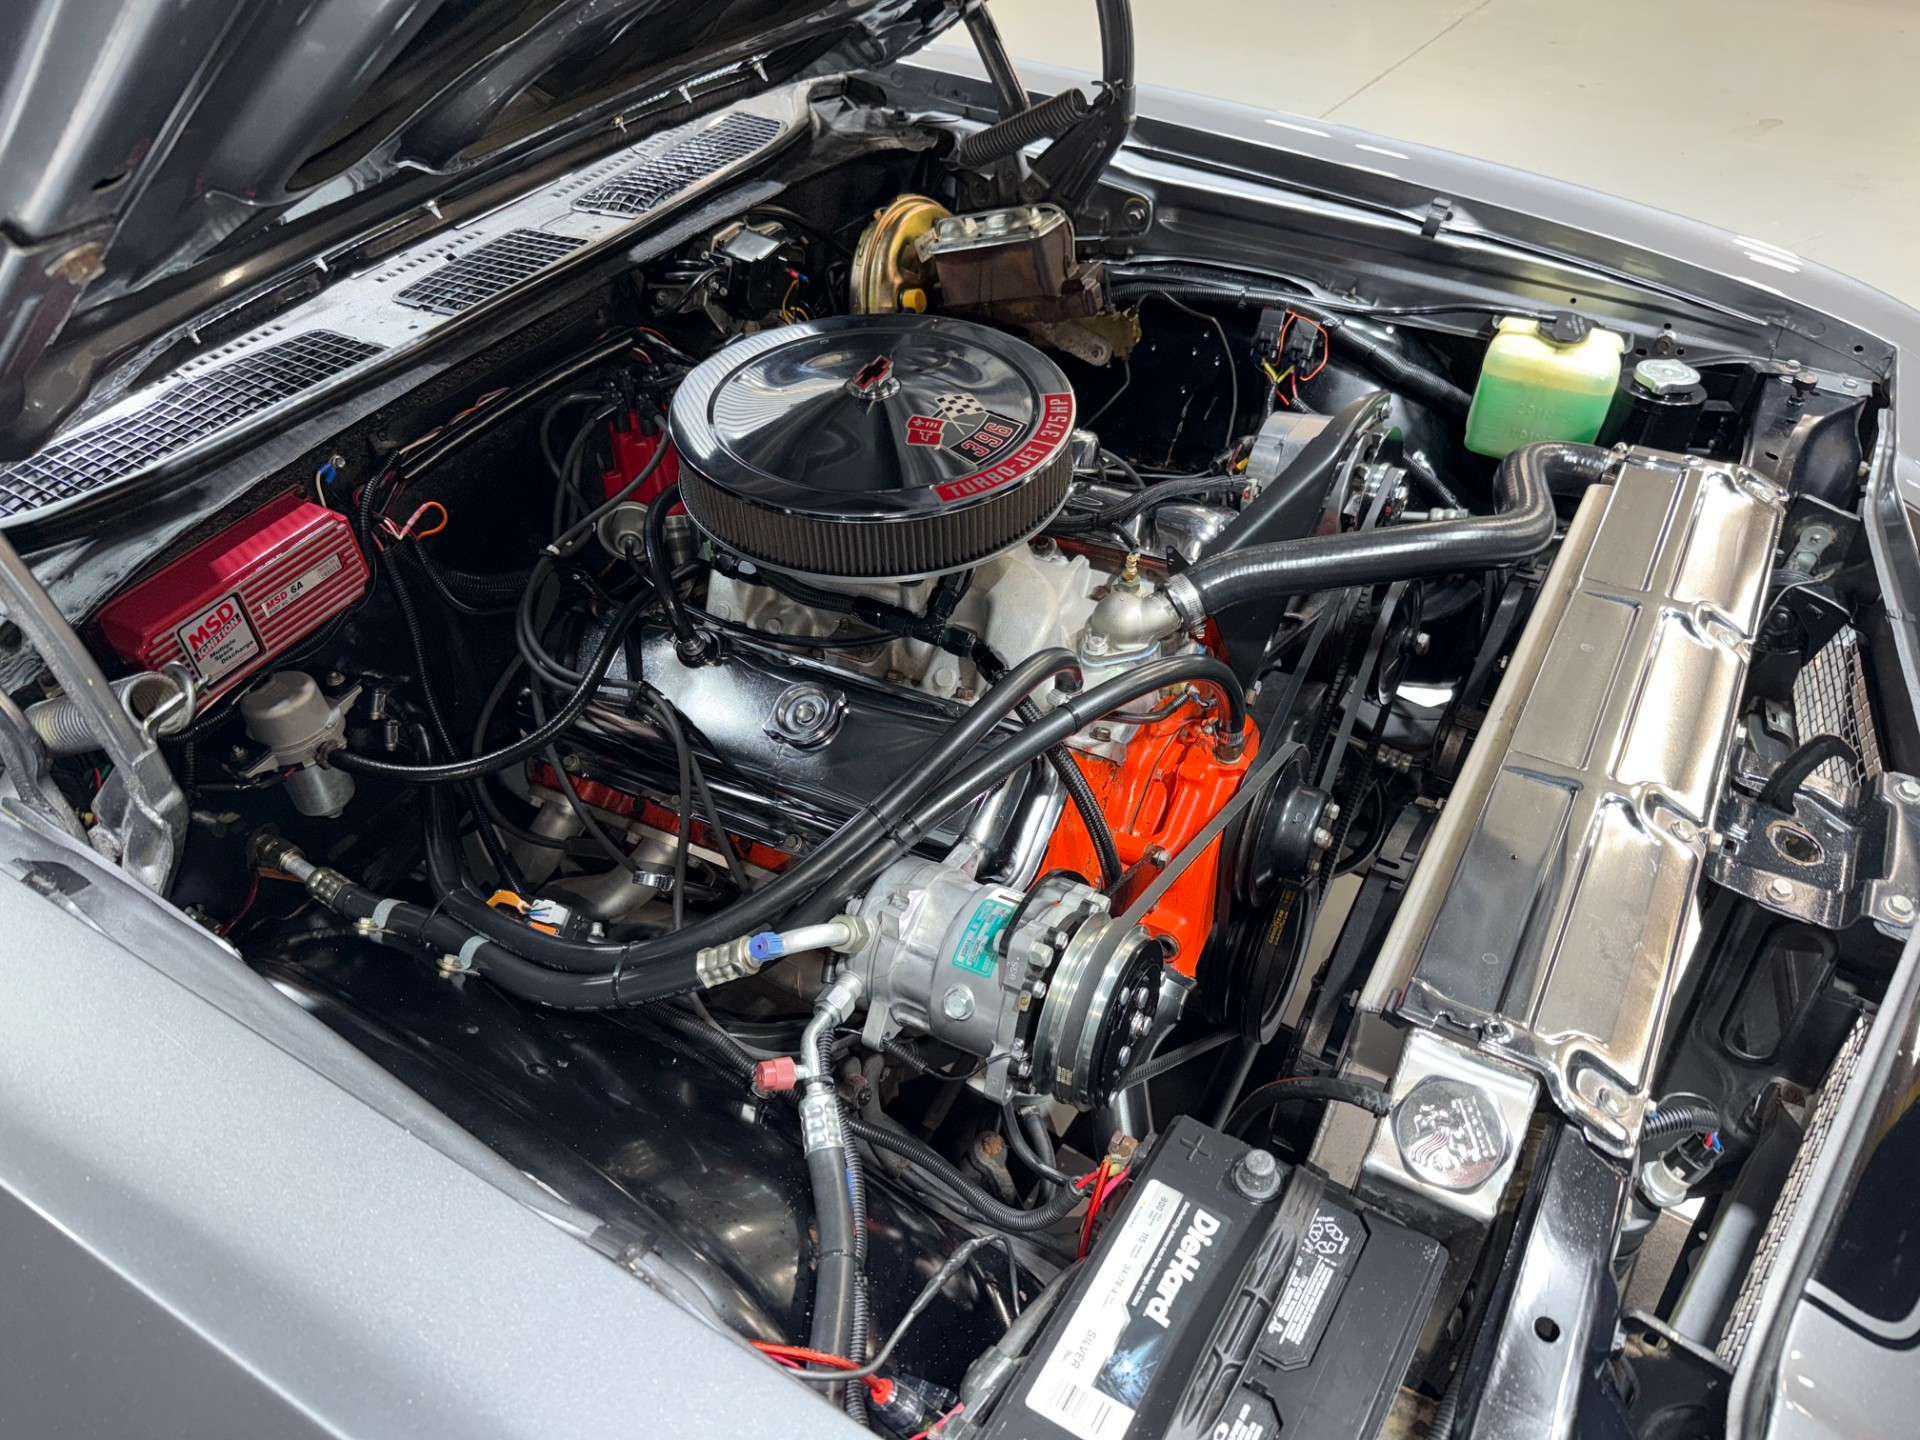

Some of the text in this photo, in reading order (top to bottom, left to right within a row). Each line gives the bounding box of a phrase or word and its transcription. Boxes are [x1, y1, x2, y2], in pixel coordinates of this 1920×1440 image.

[961, 422, 1013, 457] 396
[946, 446, 1046, 497] TURBO-JET
[265, 581, 304, 610] MSD 6A
[188, 603, 235, 652] MSD
[197, 617, 239, 660] IGNITION
[221, 640, 254, 665] Discharge
[1155, 1195, 1169, 1212] 800
[1137, 1231, 1149, 1244] 115
[1144, 1208, 1221, 1329] DieHard
[1070, 1329, 1097, 1369] SILVER
